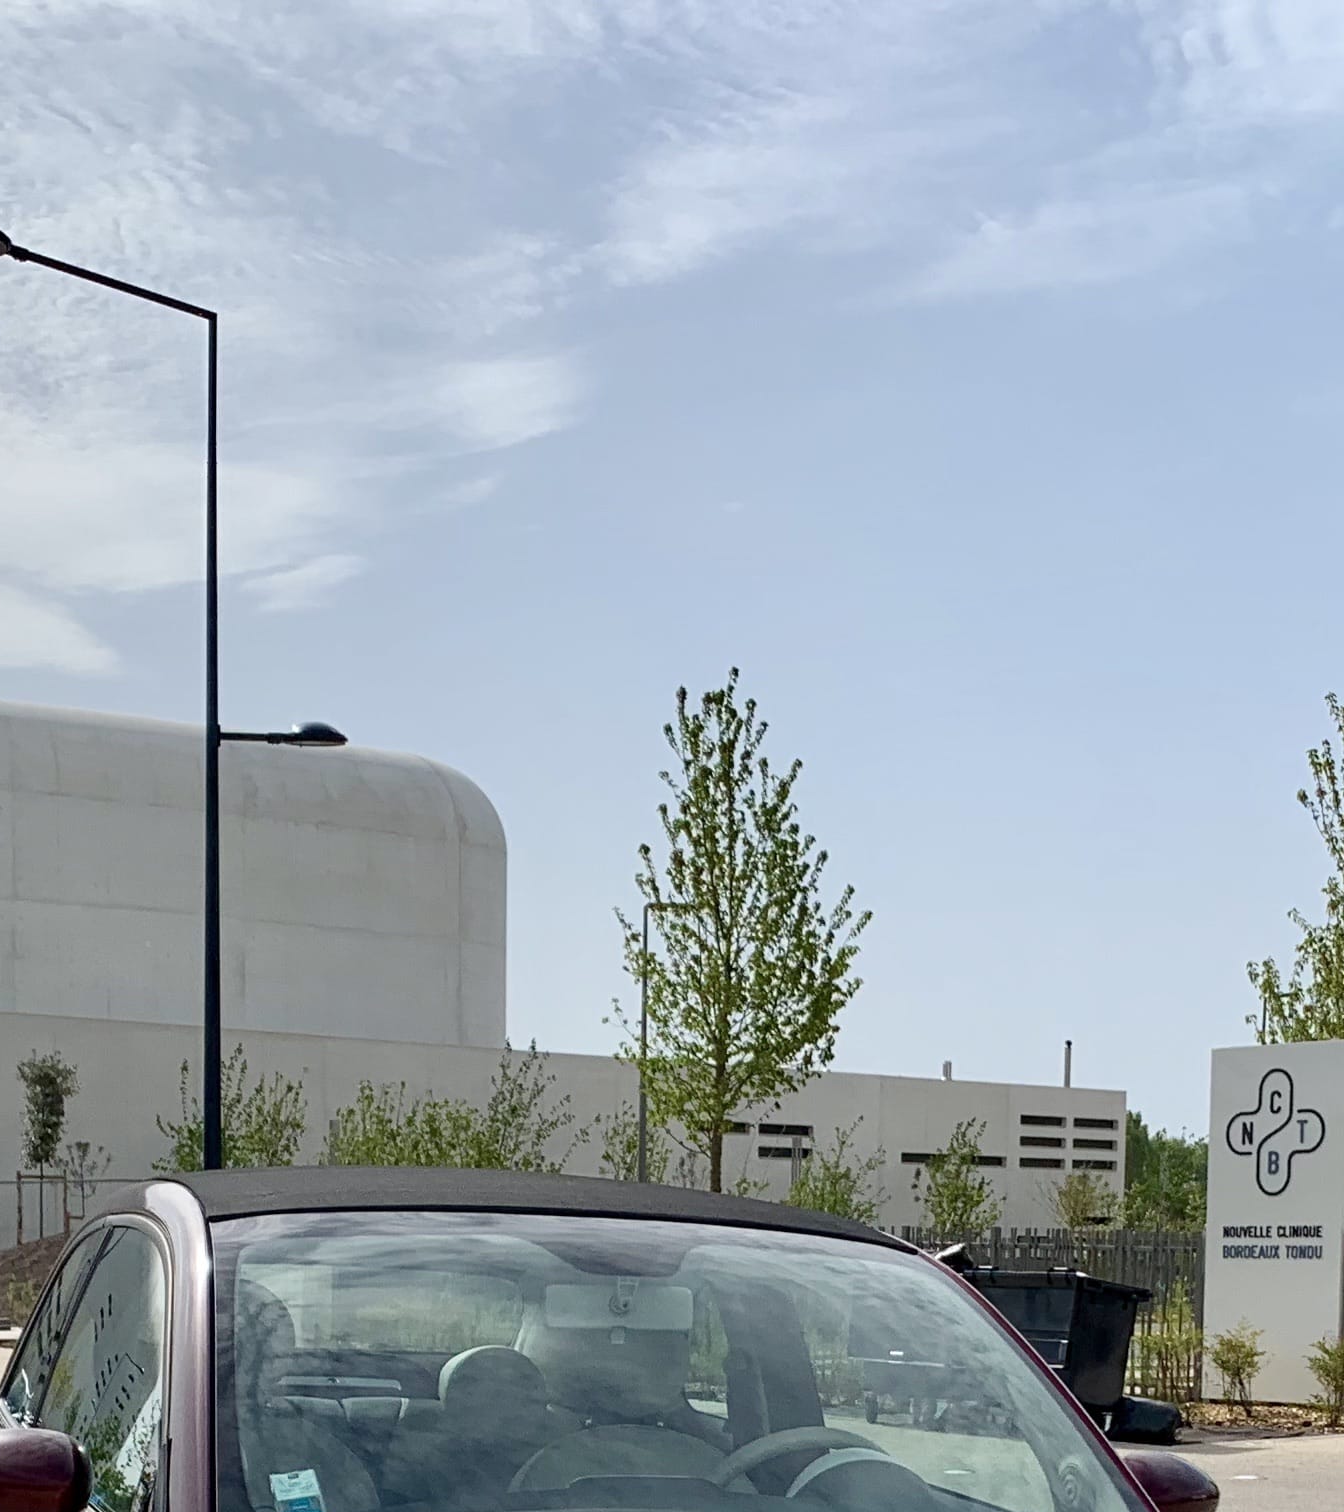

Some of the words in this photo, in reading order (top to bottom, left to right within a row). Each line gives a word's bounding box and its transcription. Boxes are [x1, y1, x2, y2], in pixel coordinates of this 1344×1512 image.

[1270, 1090, 1282, 1114] C
[1242, 1121, 1253, 1145] N
[1297, 1120, 1308, 1144] T
[1268, 1151, 1279, 1175] B
[1223, 1226, 1272, 1238] NOUVELLE
[1277, 1225, 1323, 1238] CLINIQUE
[1223, 1245, 1280, 1259] BORDEAUX
[1285, 1245, 1323, 1259] TONDU
